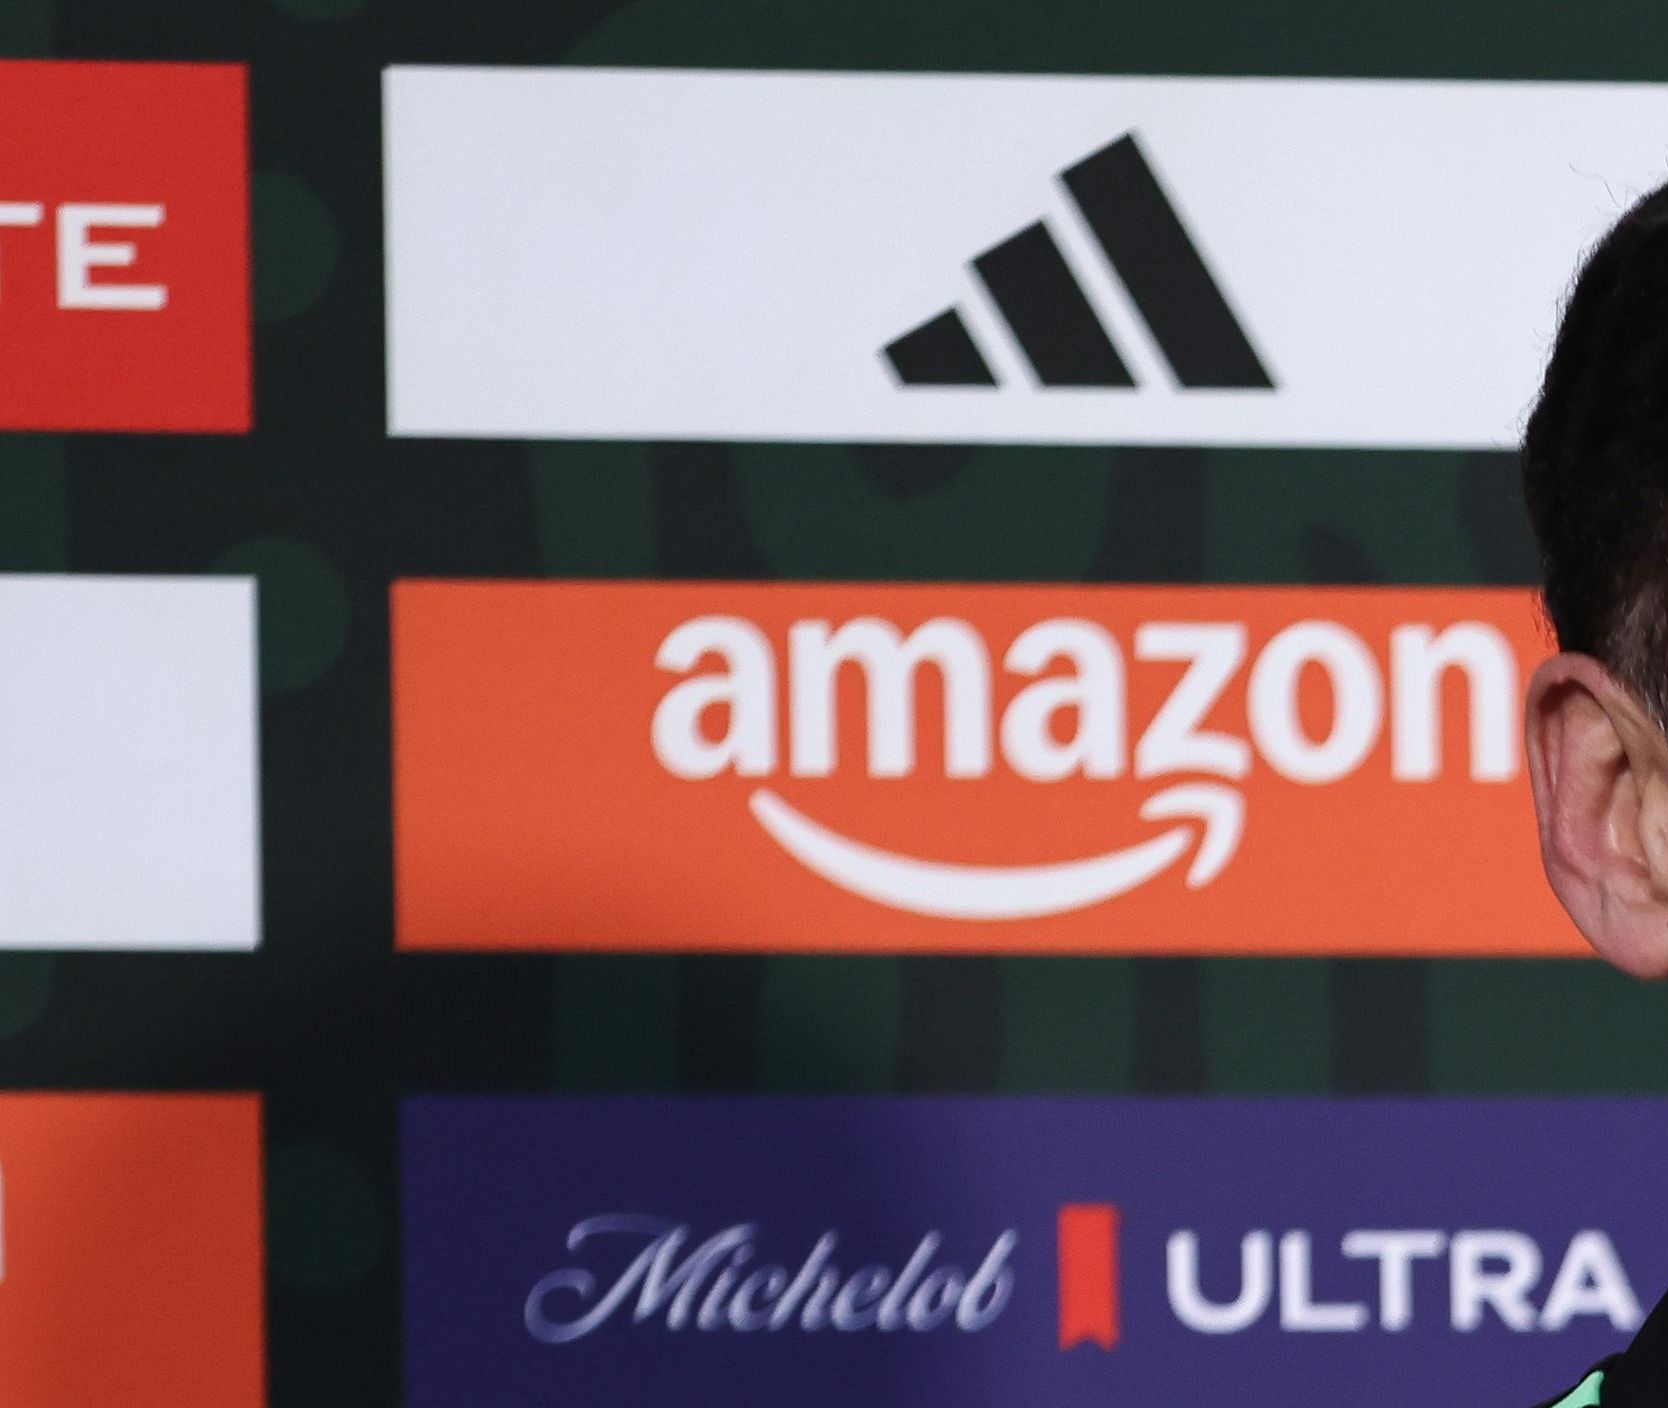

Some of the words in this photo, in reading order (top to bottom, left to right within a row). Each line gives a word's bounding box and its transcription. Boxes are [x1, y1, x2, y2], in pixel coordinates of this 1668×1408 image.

[651, 613, 1521, 786] amazon
[523, 1211, 1013, 1343] Michelob
[1164, 1228, 1643, 1334] ULTRA
